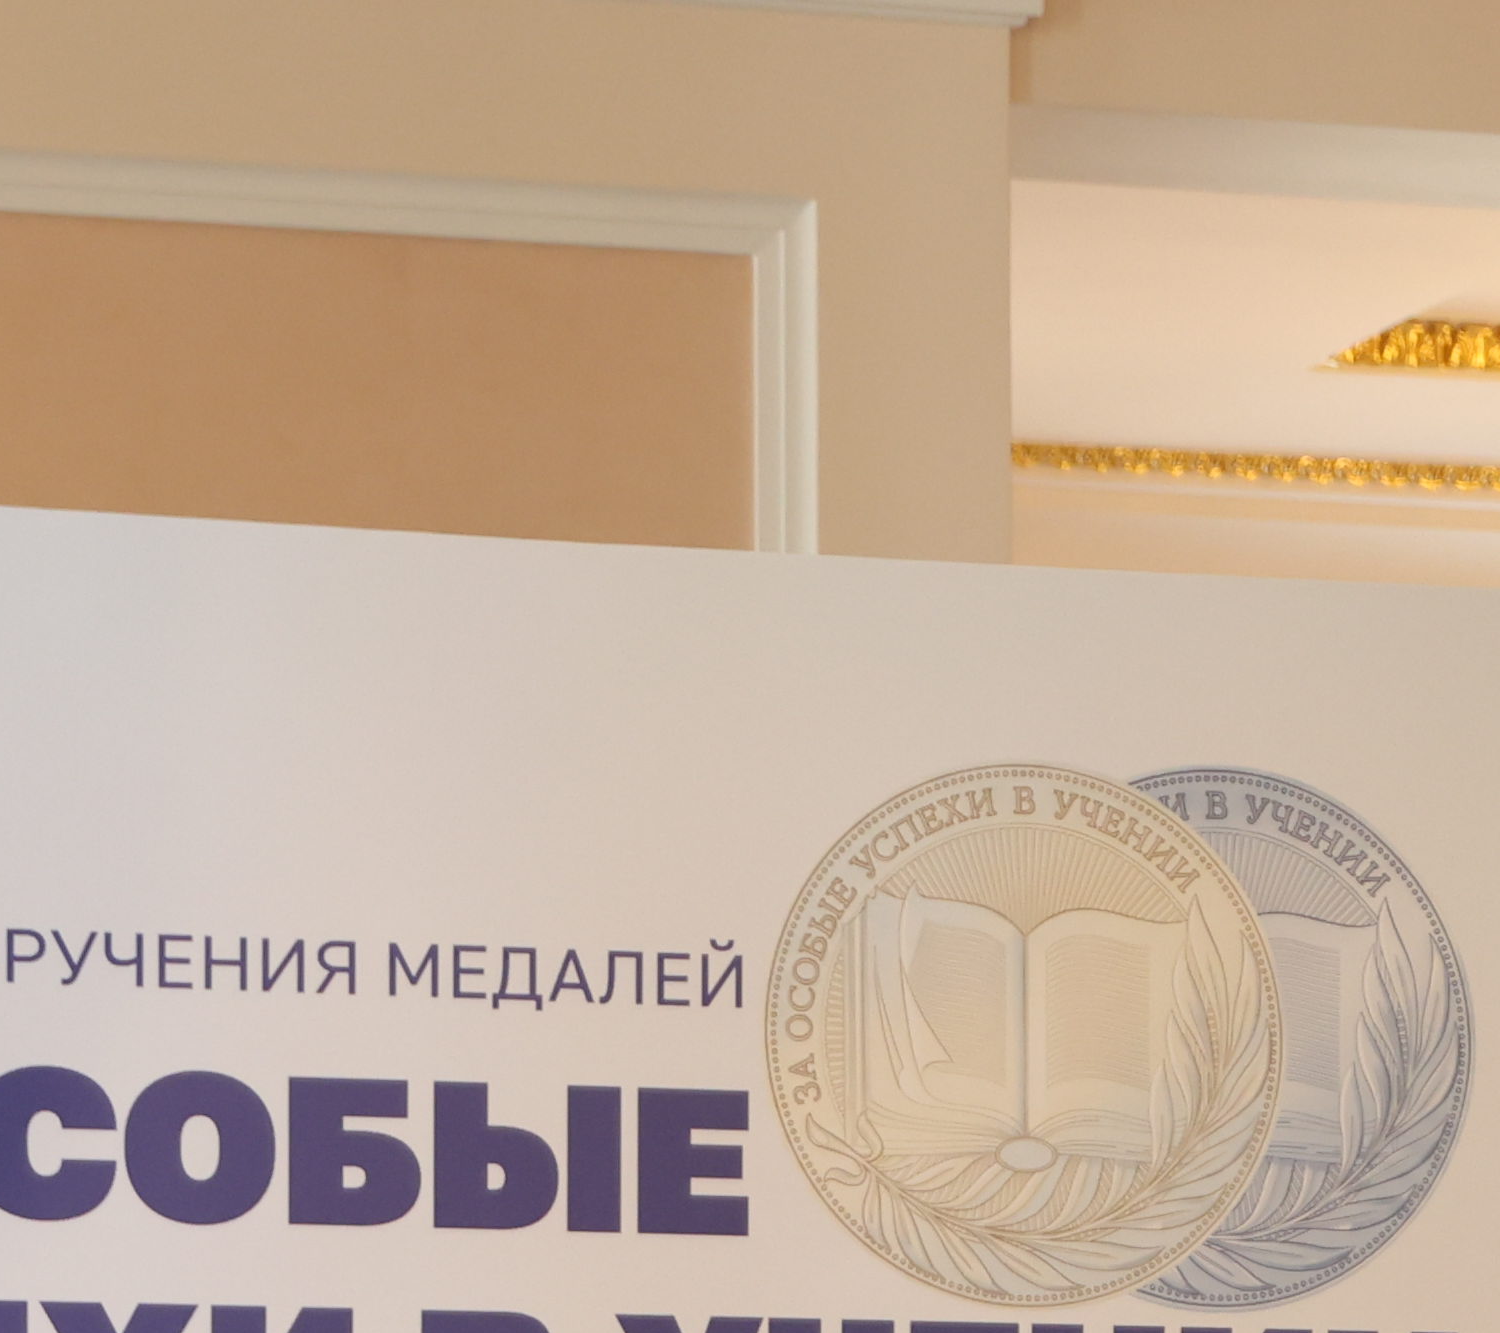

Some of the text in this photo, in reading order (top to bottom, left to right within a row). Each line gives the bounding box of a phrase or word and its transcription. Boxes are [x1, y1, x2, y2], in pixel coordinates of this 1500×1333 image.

[1205, 790, 1229, 820] В
[1245, 793, 1392, 898] УЧЕНИИ
[388, 939, 743, 1011] МЕДАЛЕЙ
[785, 785, 1201, 1105] ЗА ОСОБЫЕ УСПЕХИ В УЧЕНИИ
